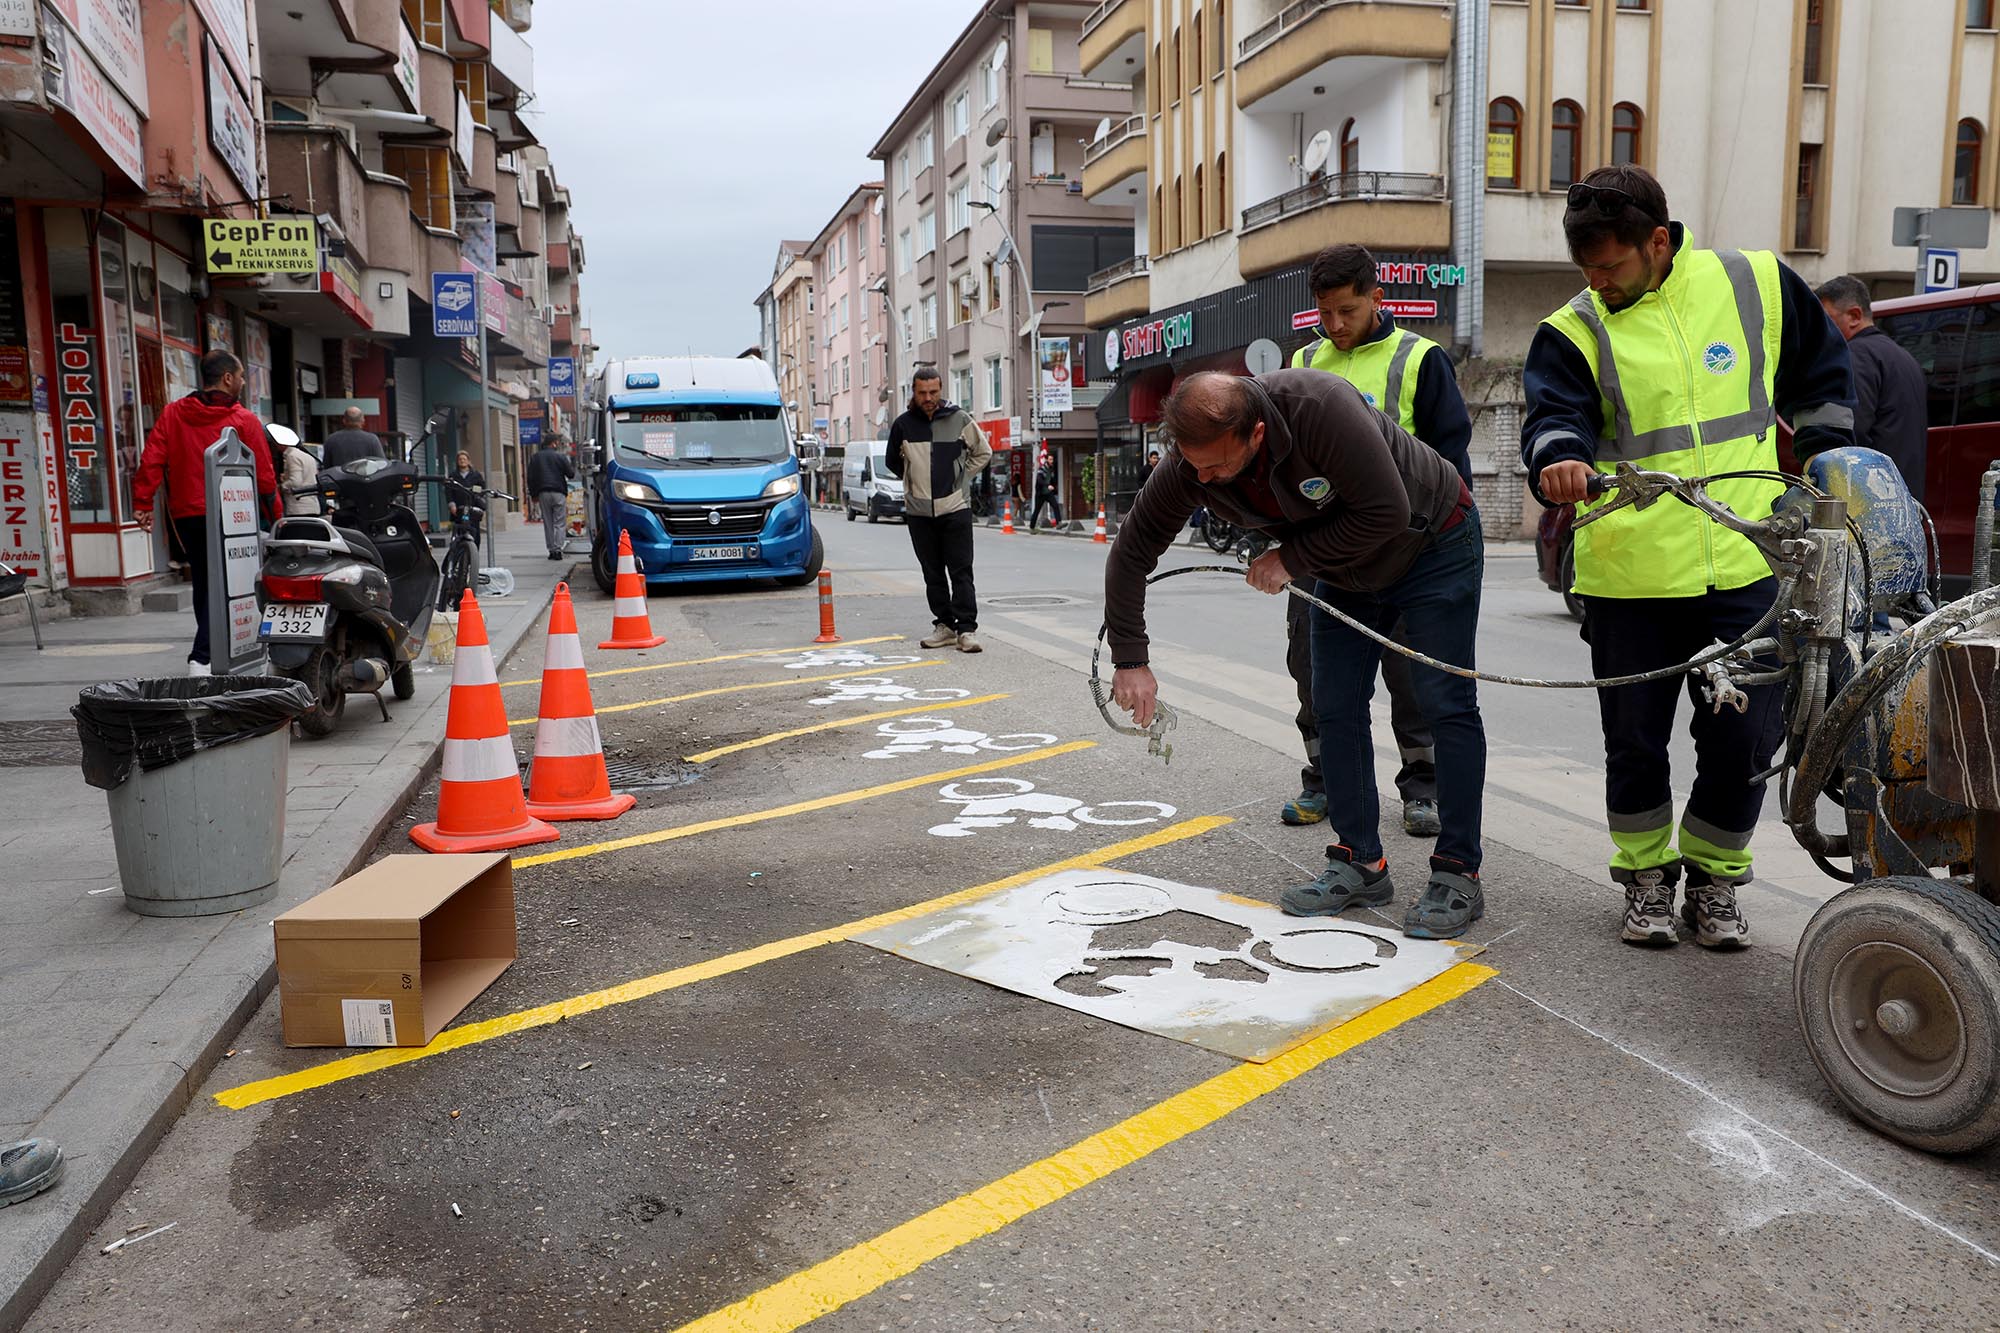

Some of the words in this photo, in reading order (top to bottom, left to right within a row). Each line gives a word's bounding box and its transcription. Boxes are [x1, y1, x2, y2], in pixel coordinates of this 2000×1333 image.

[210, 222, 309, 245] CepFon
[240, 248, 264, 257] ACİL
[265, 248, 299, 257] TAMİR
[300, 249, 308, 257] &
[236, 260, 275, 269] TEKNİK
[275, 260, 314, 269] SERVİS
[1934, 258, 1948, 284] D
[437, 316, 474, 333] SERDİVAN
[551, 383, 573, 393] KAMPÜS
[643, 414, 672, 423] AGORA
[0, 438, 27, 547] TERZİ
[43, 432, 59, 547] TERZİ
[0, 549, 41, 561] İbrahim
[694, 549, 706, 559] 54
[709, 549, 718, 558] M
[720, 548, 742, 558] 0081
[266, 606, 287, 619] 34
[292, 606, 325, 619] HEN
[279, 621, 312, 634] 332
